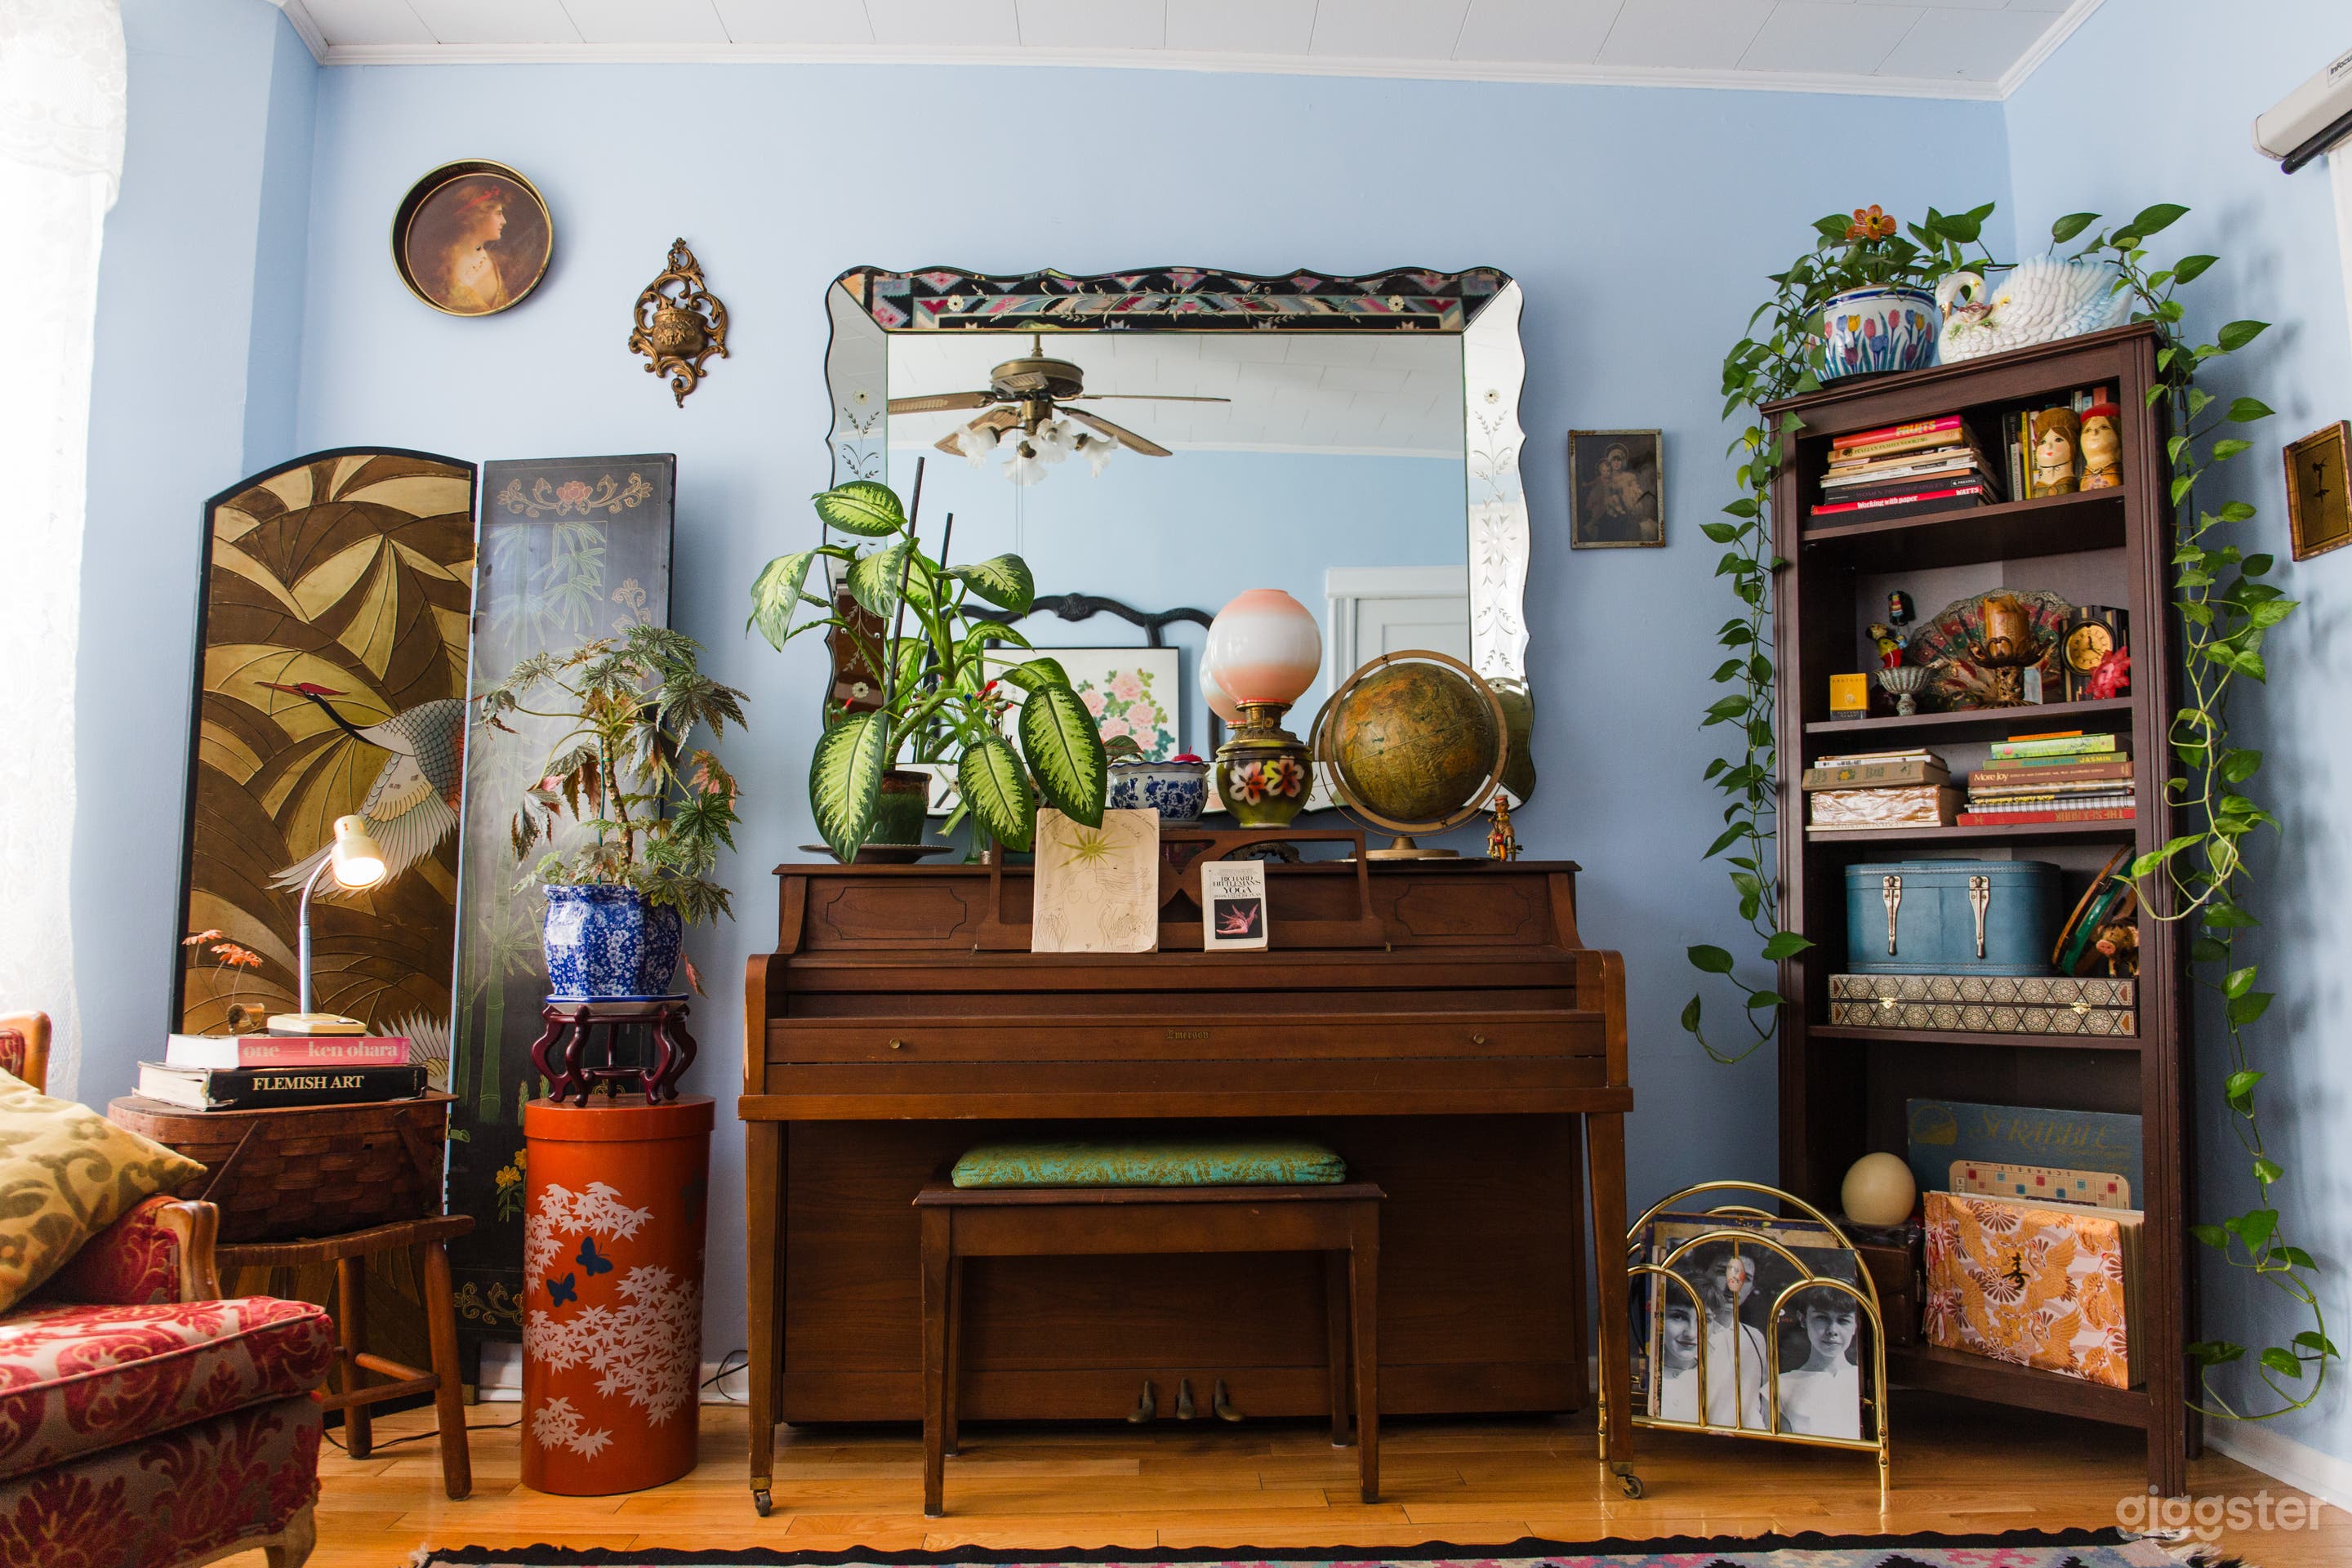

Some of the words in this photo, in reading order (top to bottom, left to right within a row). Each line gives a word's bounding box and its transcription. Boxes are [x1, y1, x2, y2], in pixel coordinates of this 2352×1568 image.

[2330, 56, 2352, 75] InFocu
[1895, 420, 1936, 437] FRUITS
[1955, 487, 1980, 496] WATTS
[1857, 500, 1884, 509] Working
[1884, 497, 1899, 506] with
[1899, 495, 1918, 506] paper
[2079, 755, 2112, 764] JASMIN
[1974, 773, 1995, 782] More
[1996, 772, 2009, 782] Joy
[2101, 808, 2123, 819] THE
[1167, 1029, 1209, 1040] Emerson
[242, 1045, 280, 1058] one
[308, 1040, 342, 1058] ken
[346, 1040, 399, 1058] ohara
[252, 1076, 327, 1091] FLEMISH
[330, 1075, 365, 1089] ART
